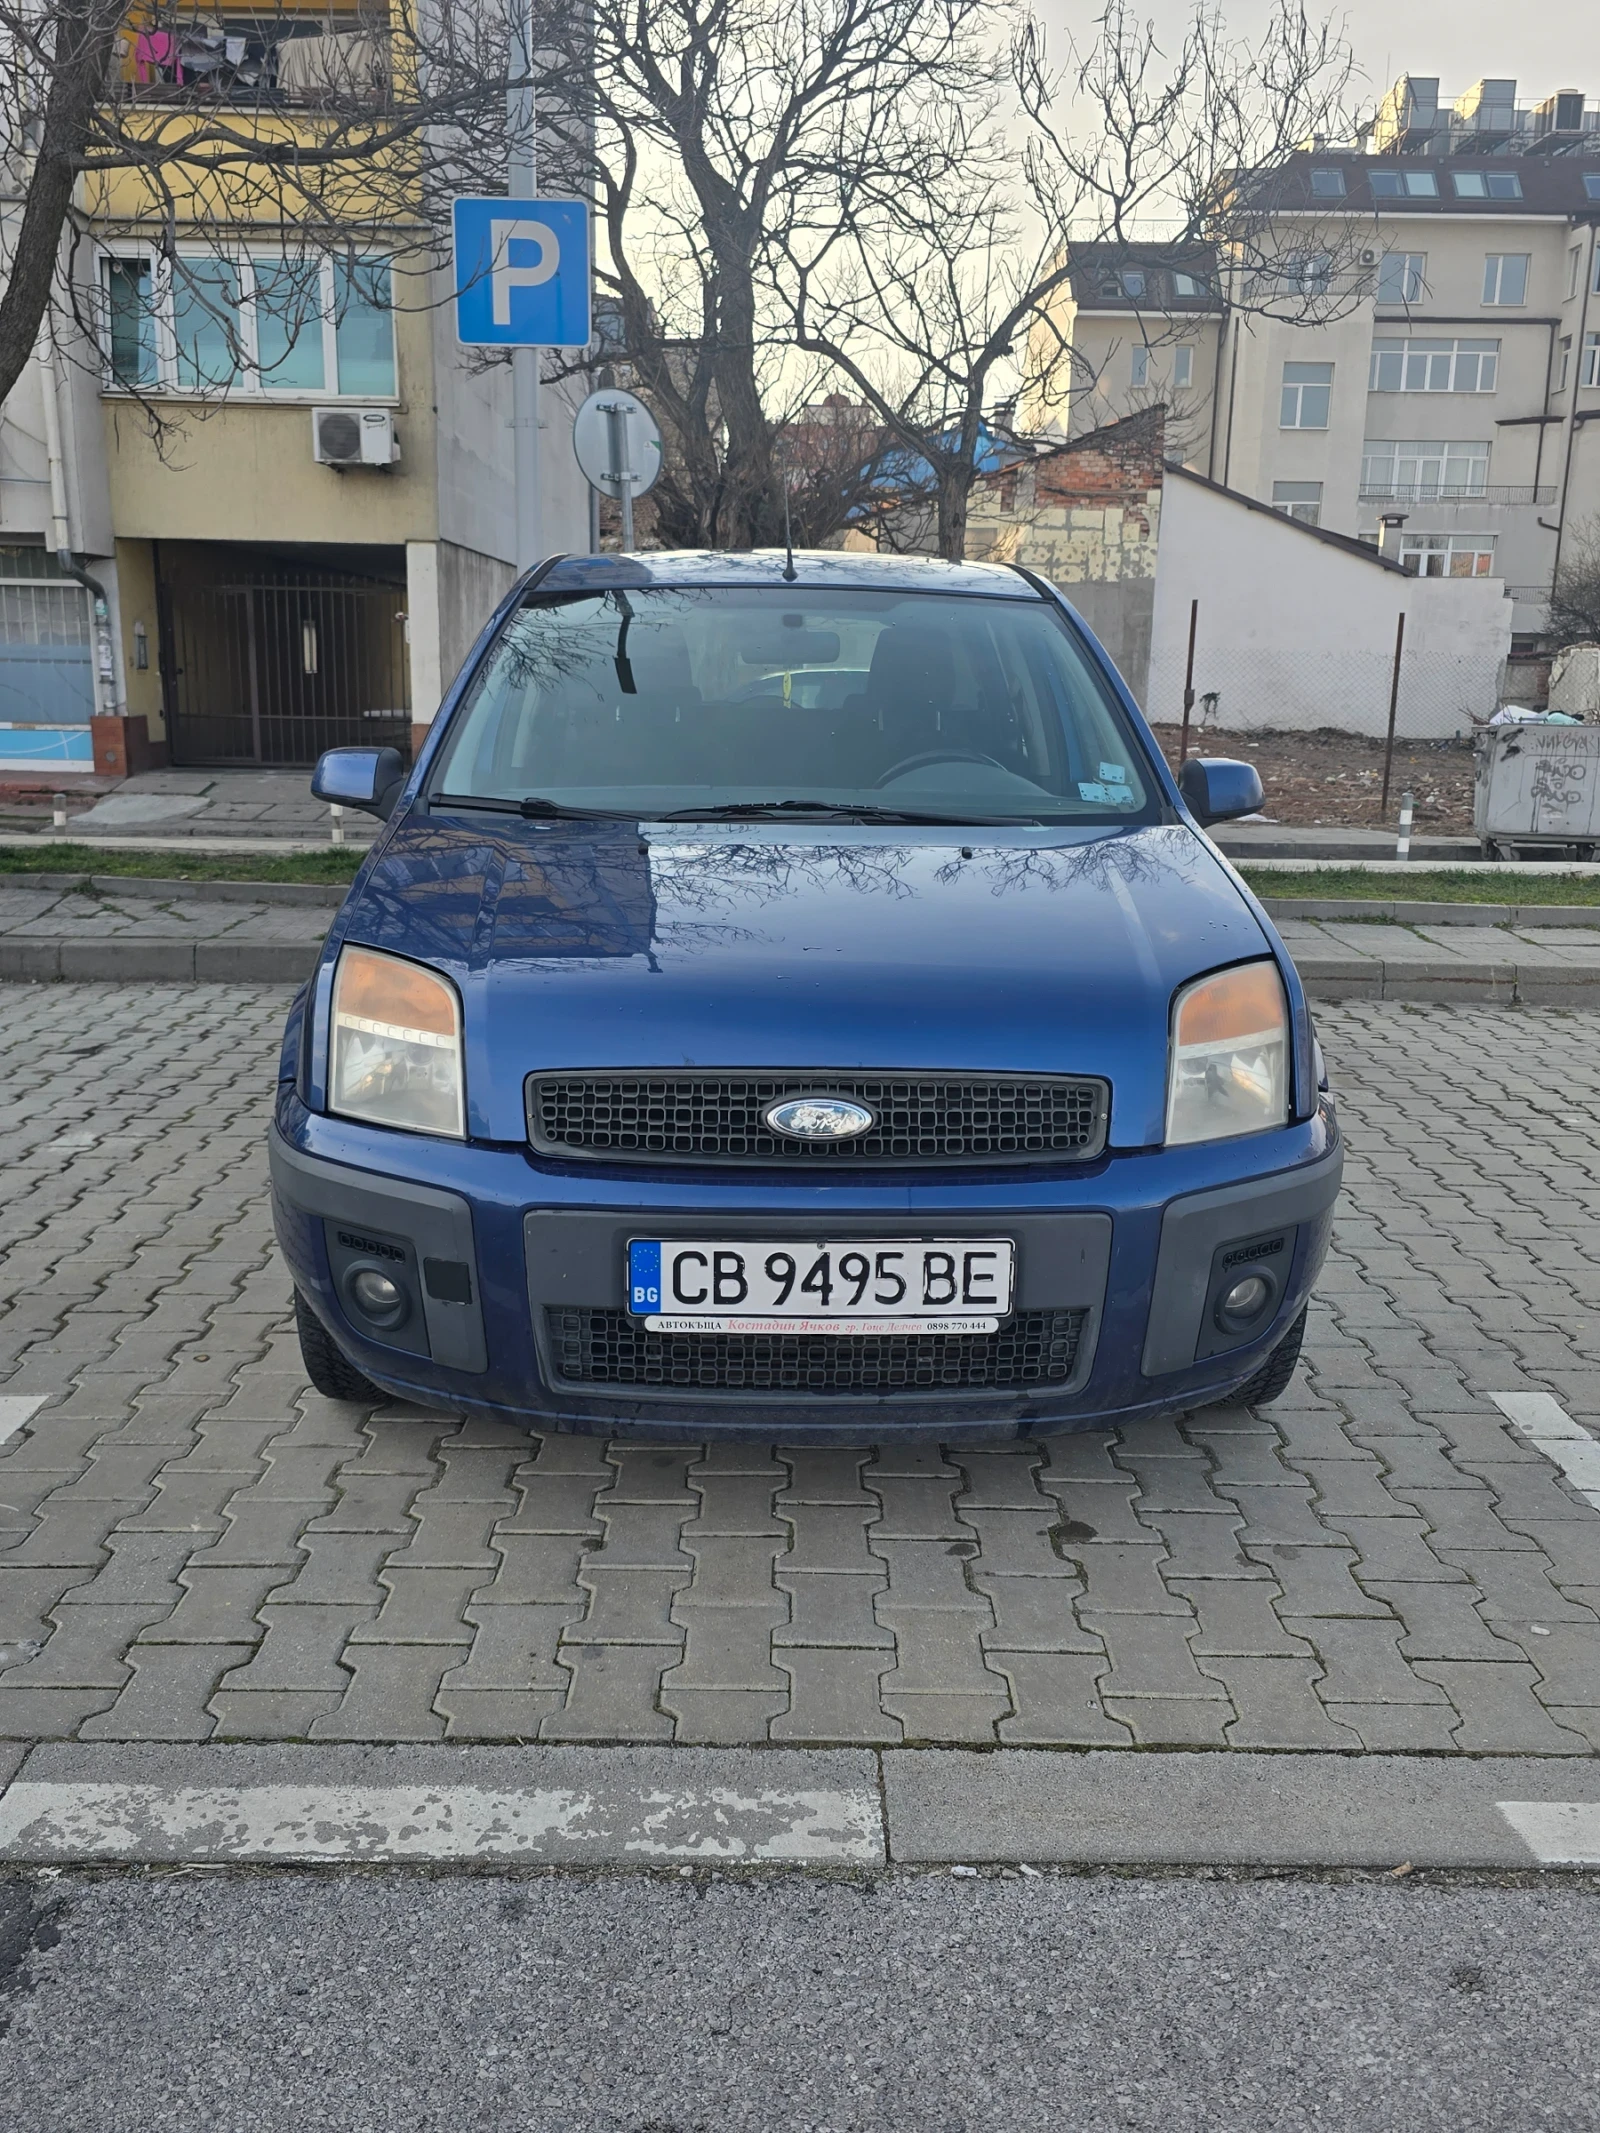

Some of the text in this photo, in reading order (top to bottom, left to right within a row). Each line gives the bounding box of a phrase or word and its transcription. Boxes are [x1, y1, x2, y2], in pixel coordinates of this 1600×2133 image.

[490, 219, 561, 326] P
[633, 1286, 658, 1303] BG
[764, 1251, 907, 1306] 9495
[922, 1251, 997, 1306] BE
[657, 1320, 722, 1331] АВТОКЪЩА
[727, 1319, 795, 1331] Костадин
[798, 1320, 840, 1332] Ячков
[926, 1321, 950, 1331] 0898
[951, 1321, 968, 1331] 770
[969, 1321, 986, 1330] 444
